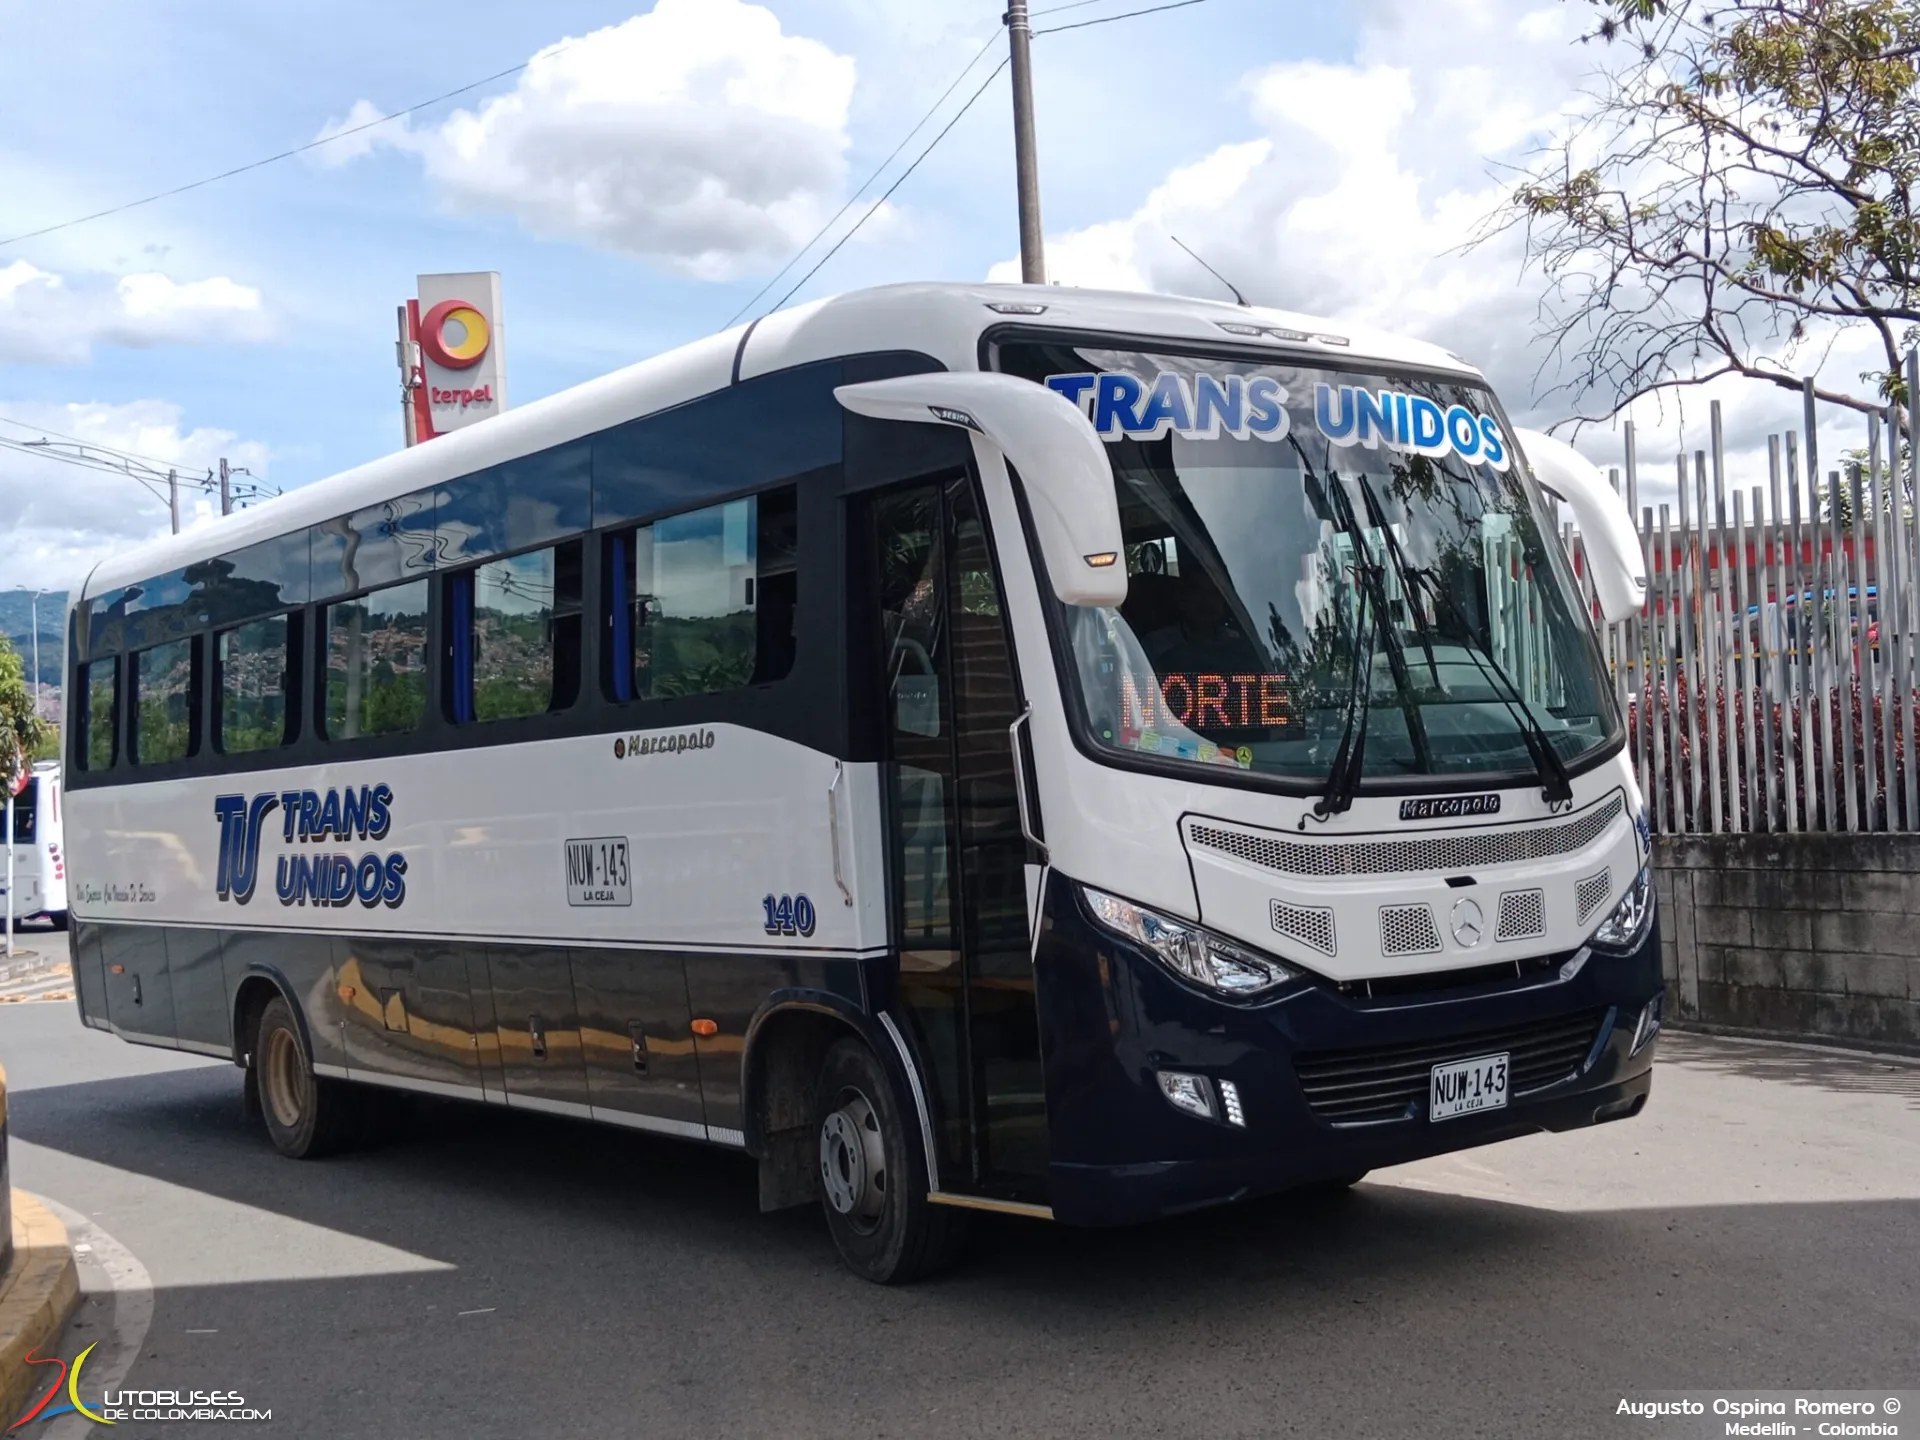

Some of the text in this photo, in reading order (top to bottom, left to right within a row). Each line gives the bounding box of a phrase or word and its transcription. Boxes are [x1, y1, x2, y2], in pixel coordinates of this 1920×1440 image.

[431, 384, 493, 407] terpel
[1045, 372, 1510, 472] TRANS UNIDOS
[1122, 672, 1289, 728] NORTE
[628, 728, 715, 757] Marcopolo
[281, 782, 394, 844] TRANS
[1402, 795, 1498, 818] Marcopolo
[276, 852, 407, 909] UNIDOS
[584, 891, 615, 901] LA CEJA
[762, 893, 816, 938] 140
[1454, 1098, 1483, 1112] LA CEJA
